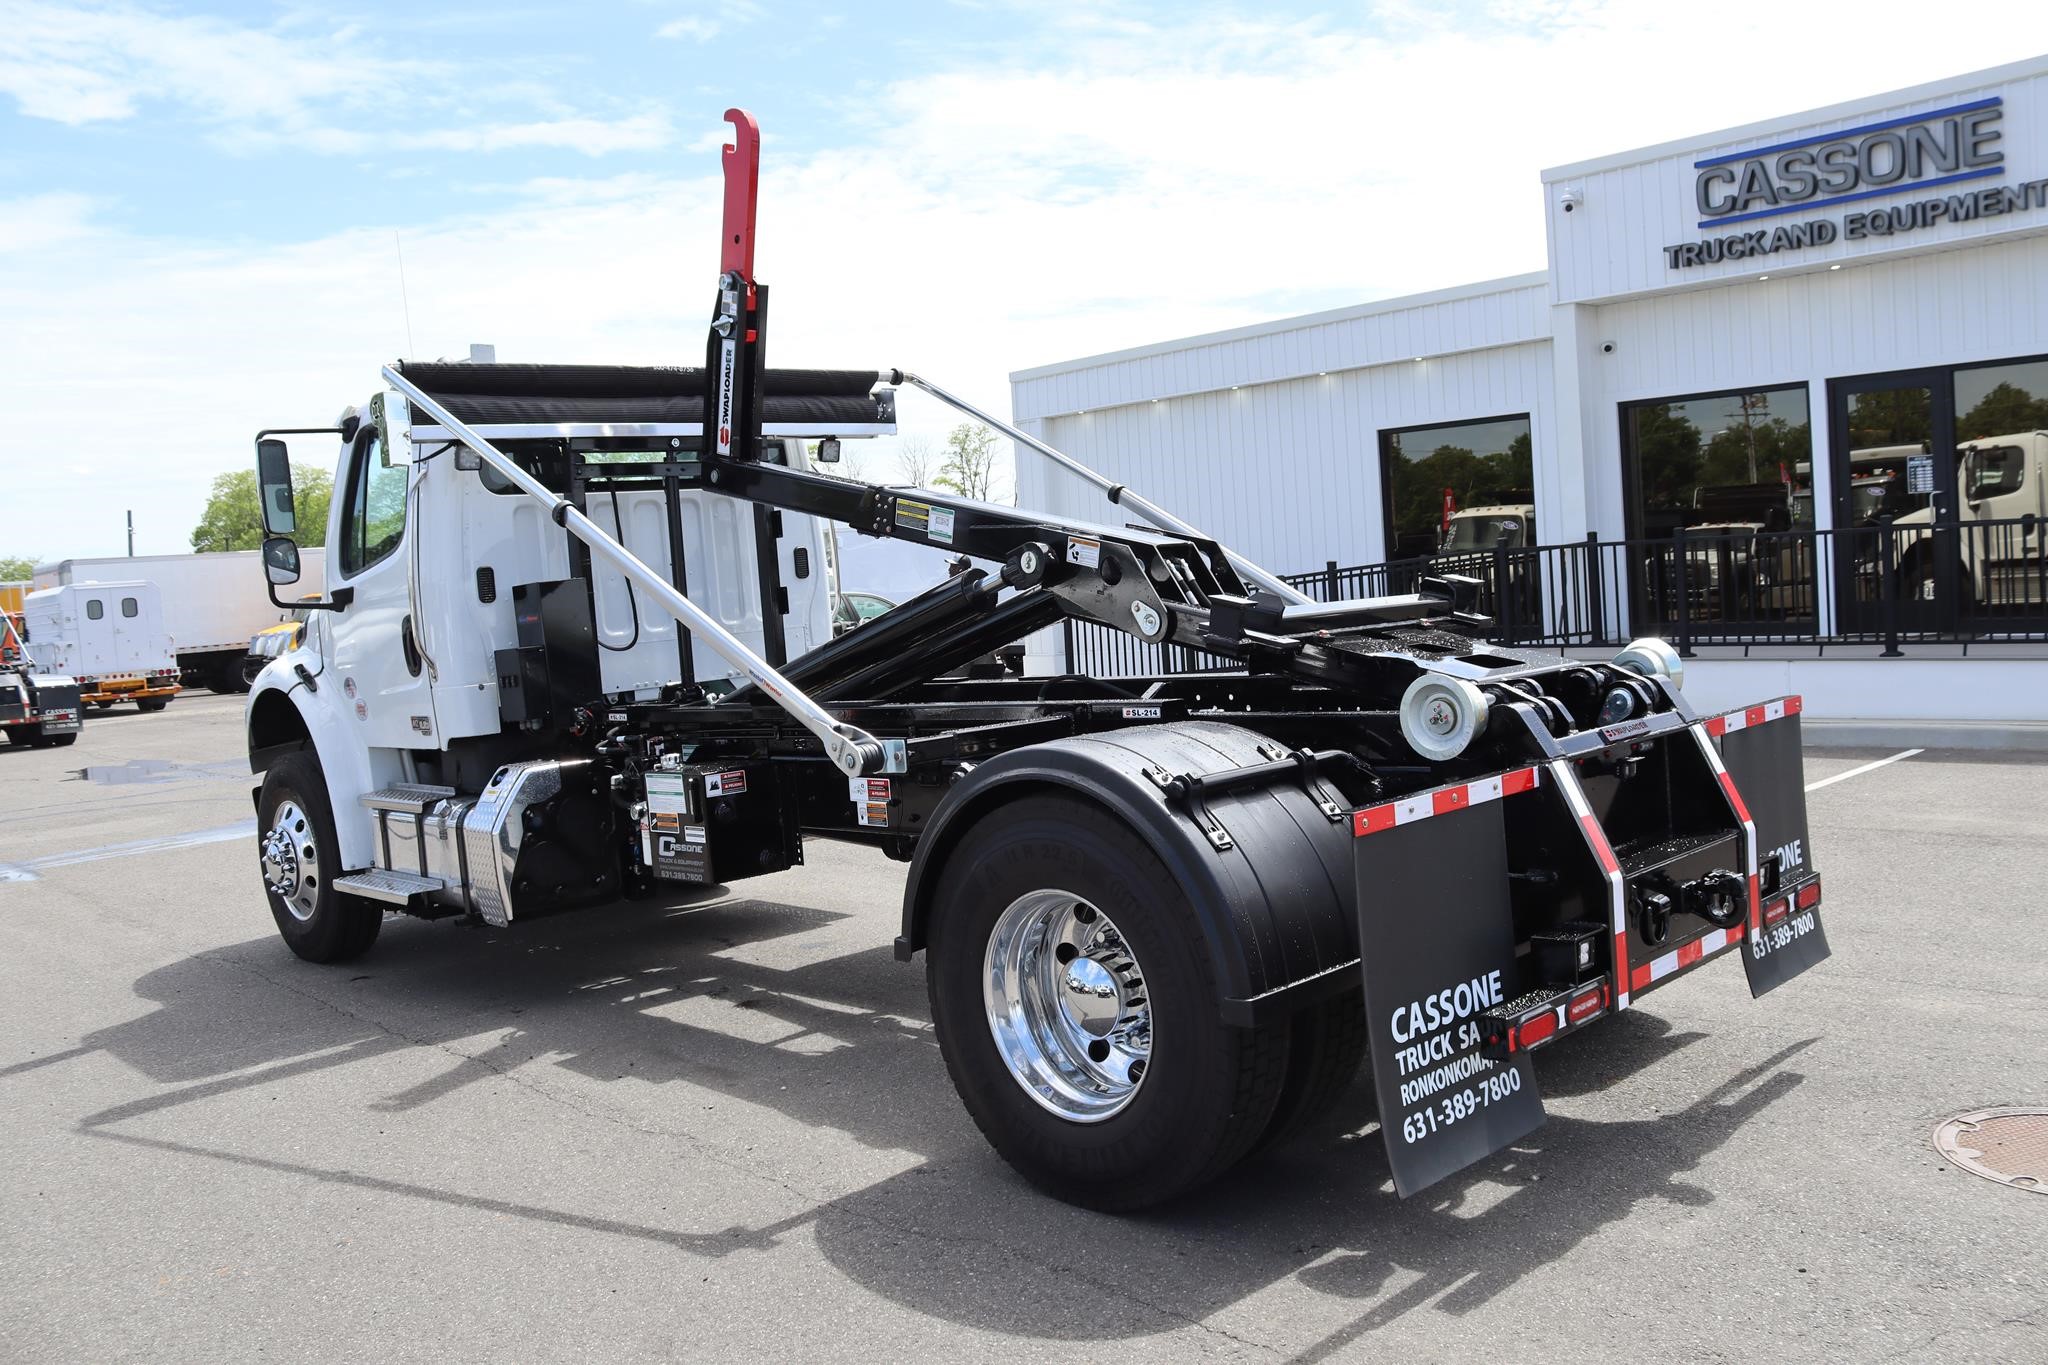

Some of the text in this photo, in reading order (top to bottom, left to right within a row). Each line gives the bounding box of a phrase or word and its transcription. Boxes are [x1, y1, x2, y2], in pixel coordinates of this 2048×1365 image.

[1695, 108, 2004, 216] CASSONE
[1844, 178, 2048, 241] EQUIPMENT
[722, 349, 733, 424] SWAPLOADER
[1131, 708, 1158, 718] SL-214
[659, 836, 703, 857] CASSONE
[1753, 912, 1815, 959] 631-389-7800
[1391, 970, 1503, 1043] CASSONE
[1395, 1031, 1454, 1076] TRUCK
[1403, 1068, 1521, 1143] 631-389-7800
